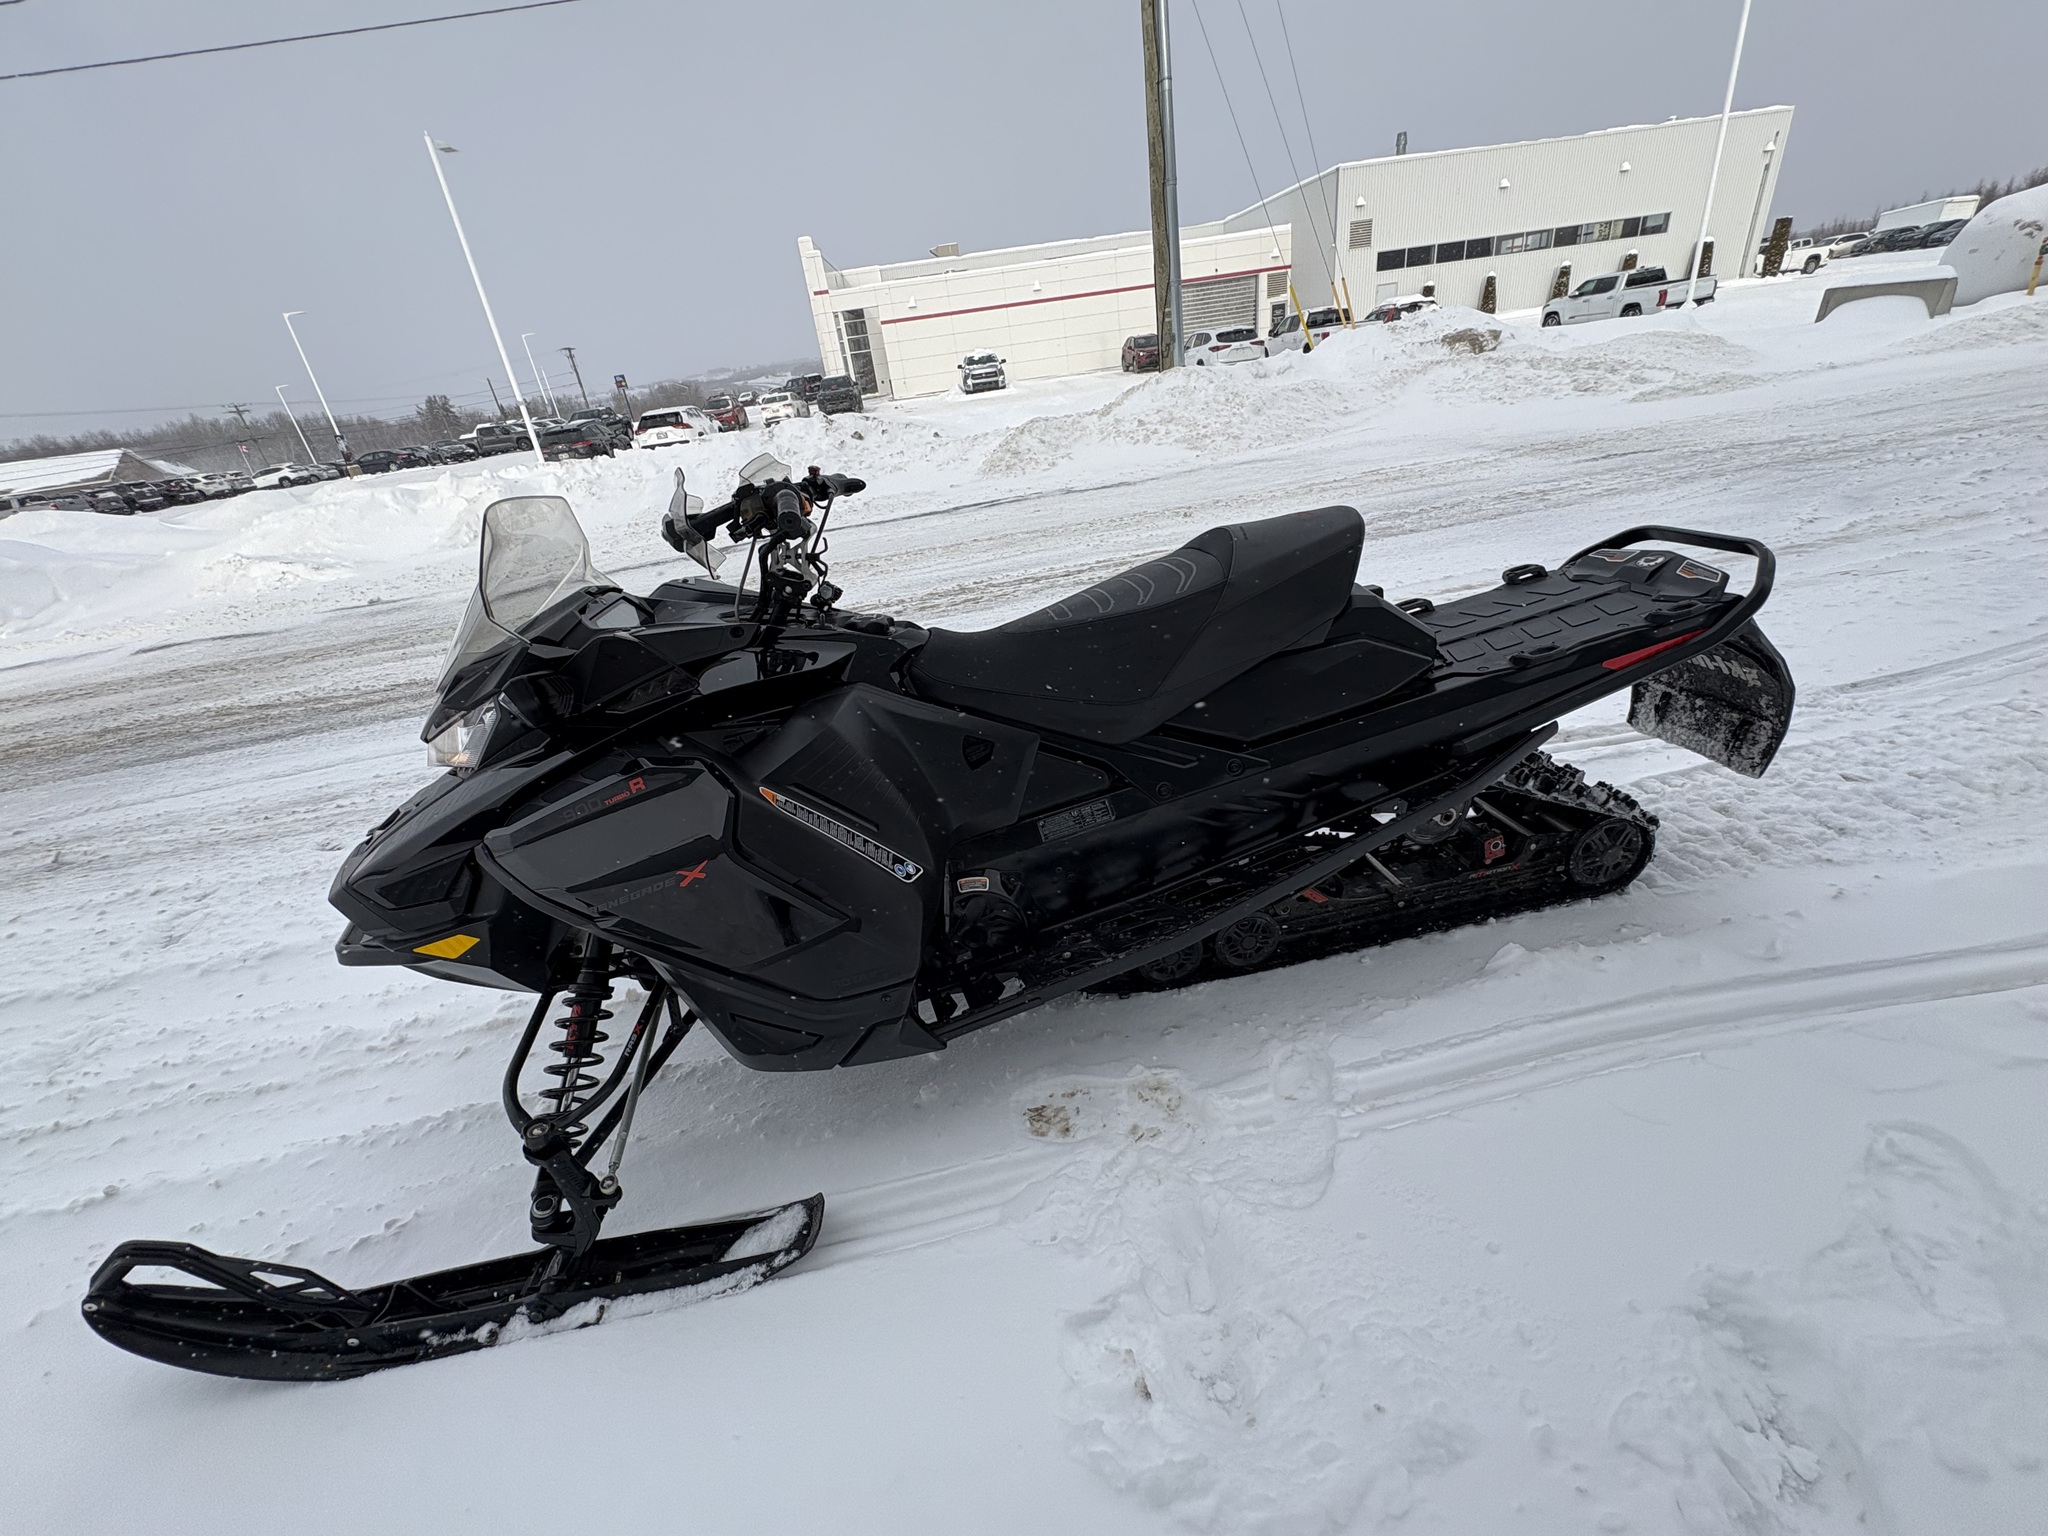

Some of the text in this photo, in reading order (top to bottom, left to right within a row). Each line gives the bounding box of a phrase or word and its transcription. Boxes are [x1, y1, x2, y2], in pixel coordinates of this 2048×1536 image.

[562, 776, 646, 822] 900 TURBO R
[587, 859, 709, 914] RENEGADE X
